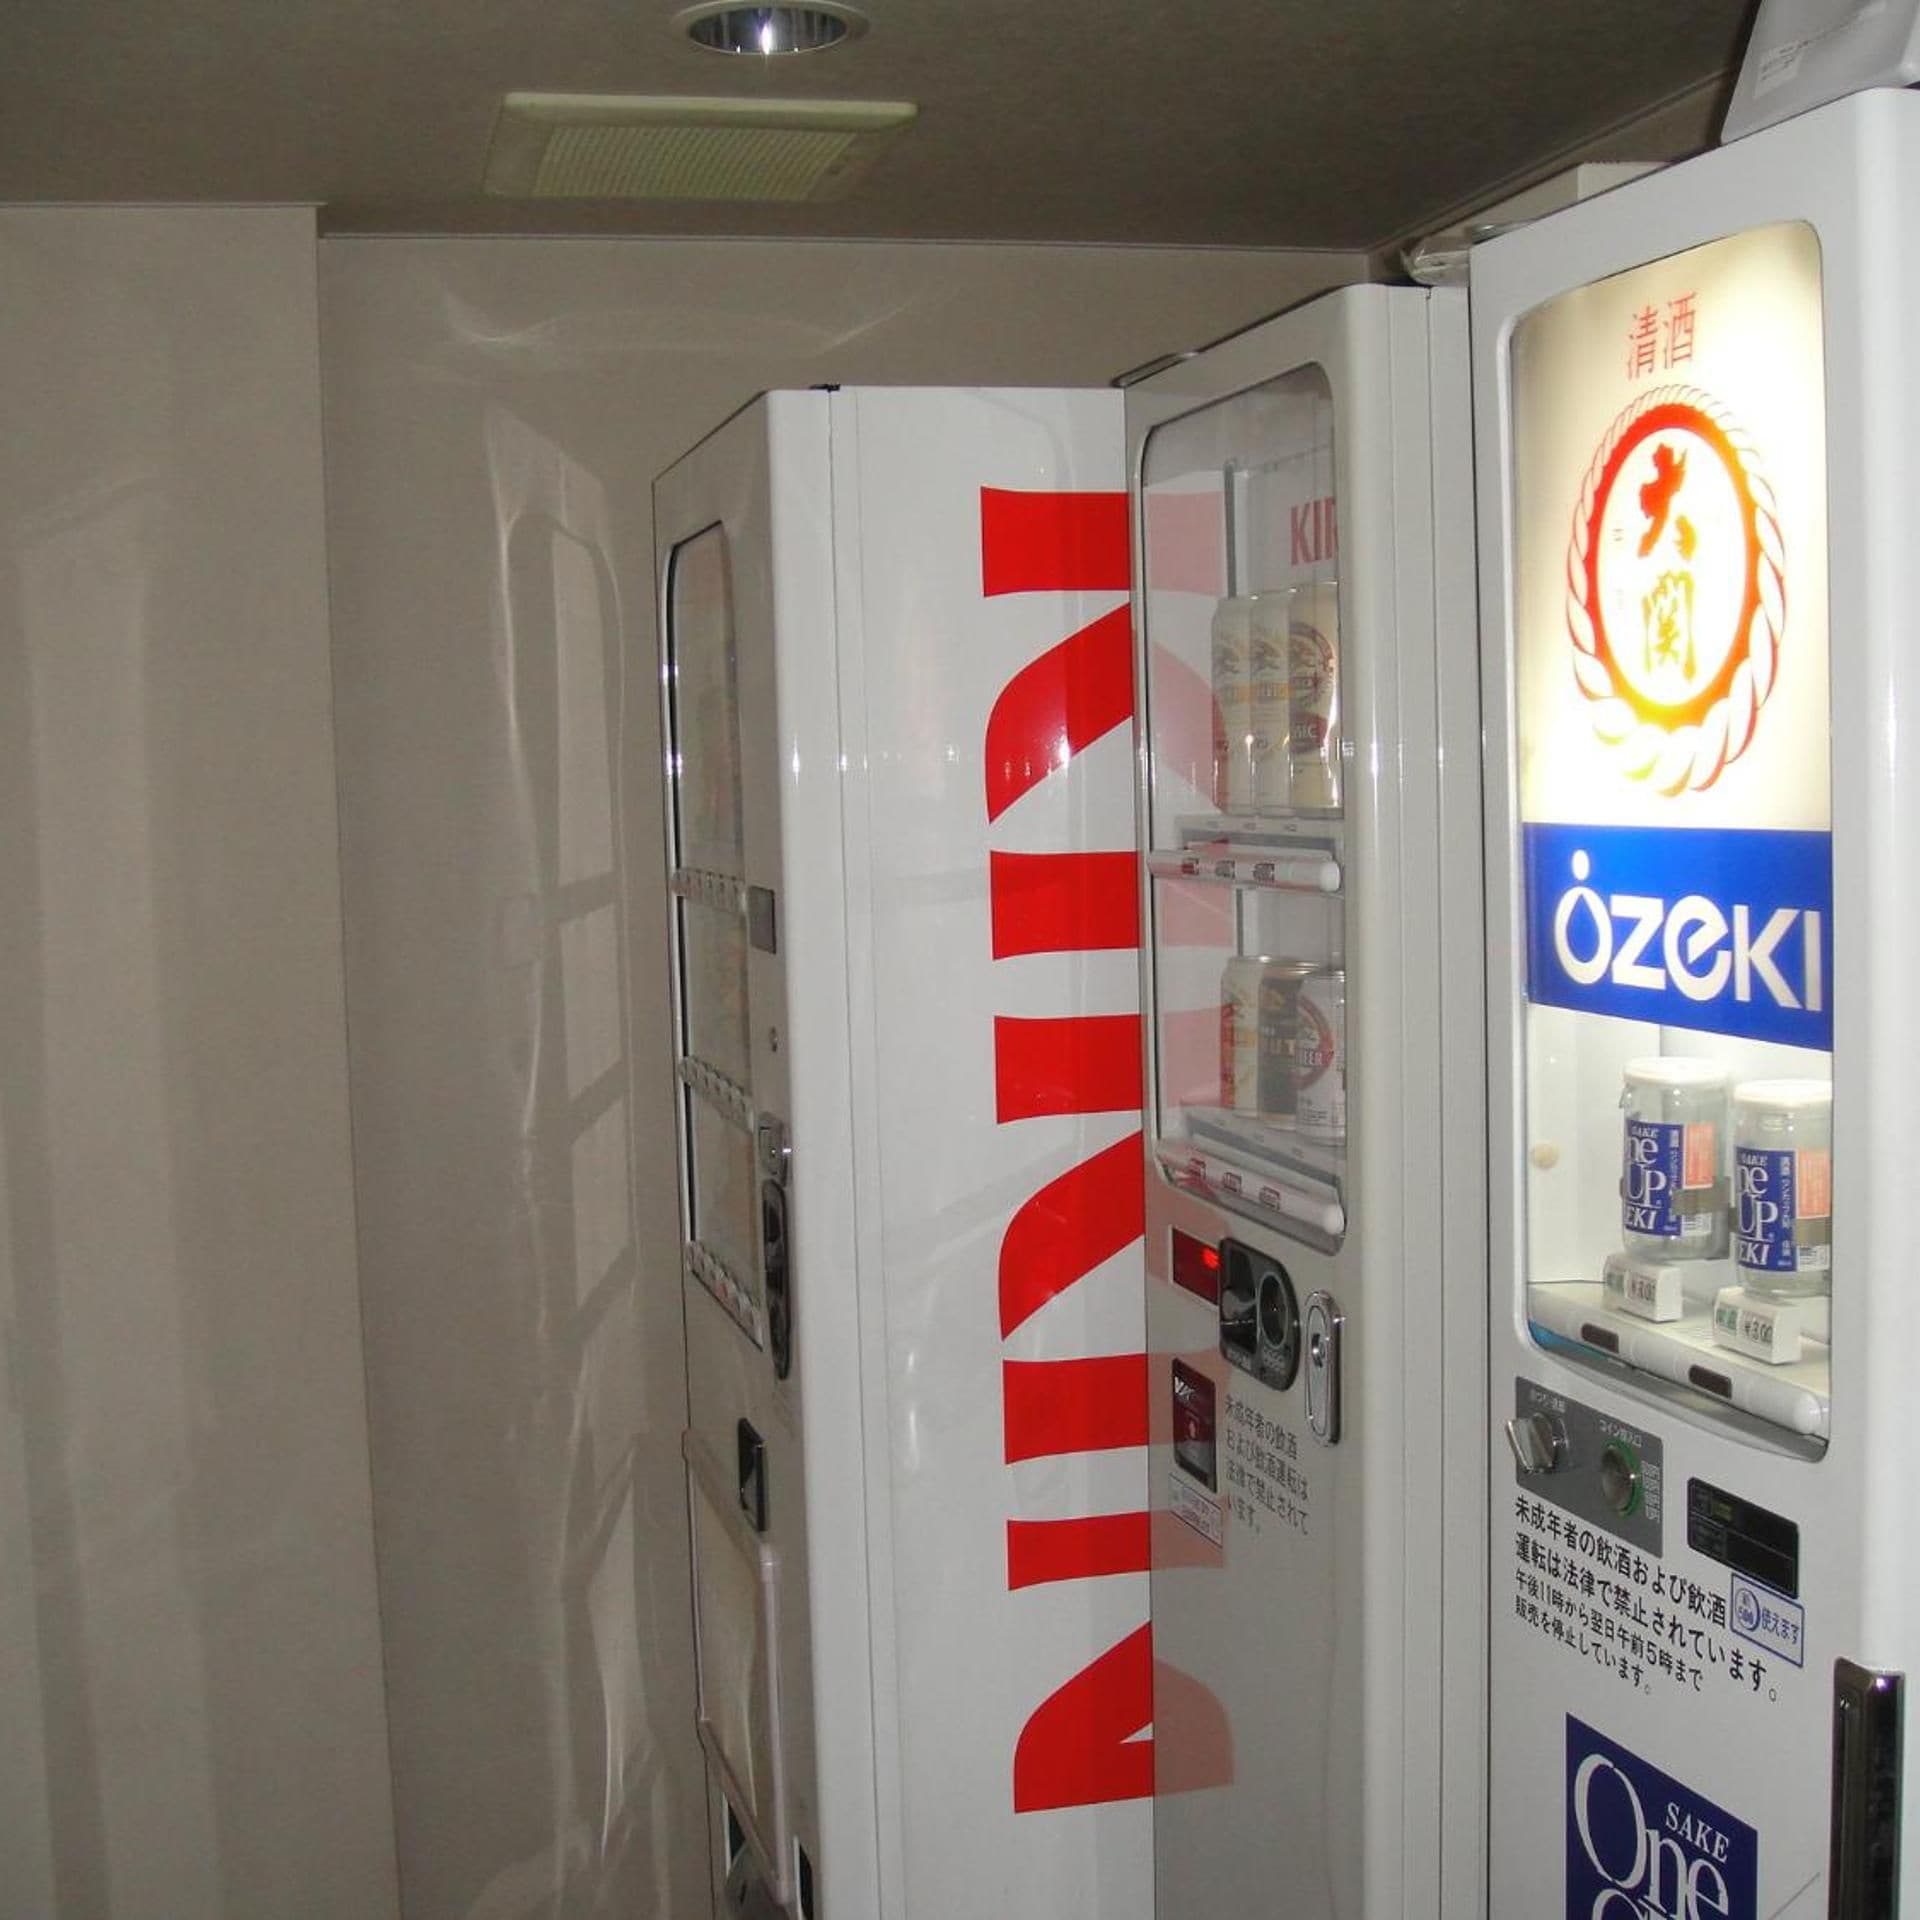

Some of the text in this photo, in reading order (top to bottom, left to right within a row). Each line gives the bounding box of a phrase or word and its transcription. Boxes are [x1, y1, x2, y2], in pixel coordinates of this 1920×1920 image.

[1626, 291, 1697, 381] 清酒
[1513, 1494, 1727, 1629] 未成年者の飲酒および飲酒
[1665, 1801, 1730, 1864] SAKE
